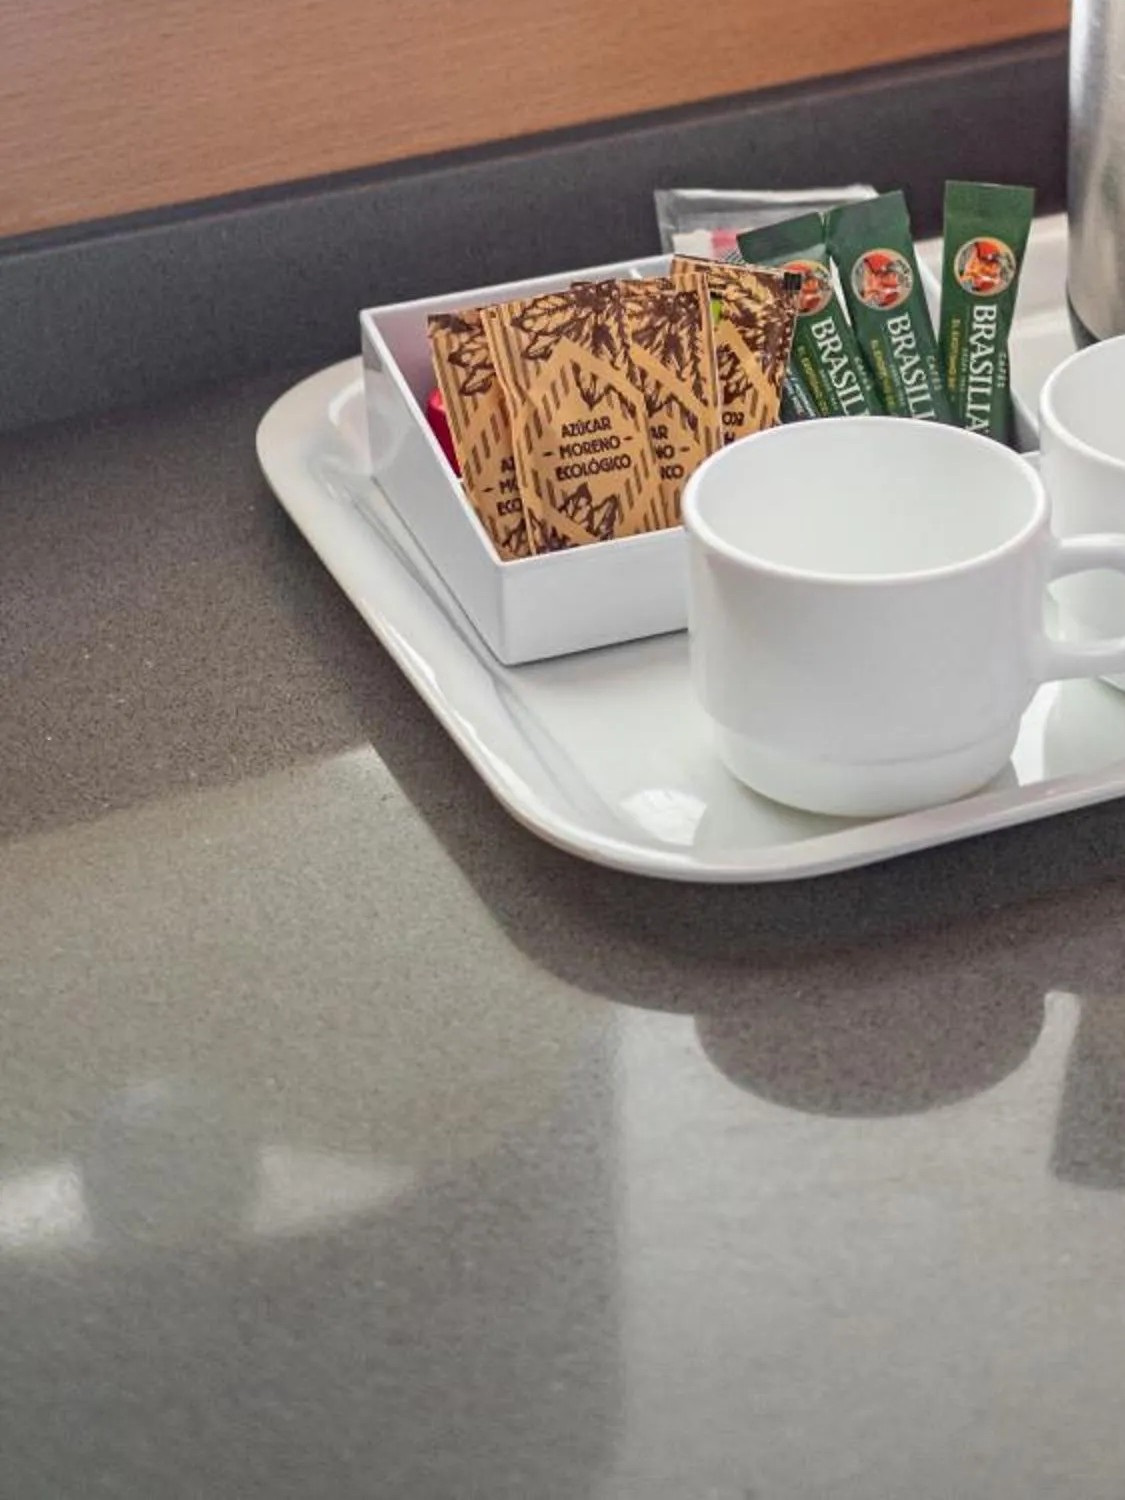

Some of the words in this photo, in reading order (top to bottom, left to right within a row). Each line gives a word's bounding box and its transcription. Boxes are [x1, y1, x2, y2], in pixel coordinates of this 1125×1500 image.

[965, 304, 997, 434] BRASILIA
[561, 415, 612, 438] AZÚCAR
[559, 435, 621, 460] MORENO
[555, 453, 632, 482] ECOLÓGICO
